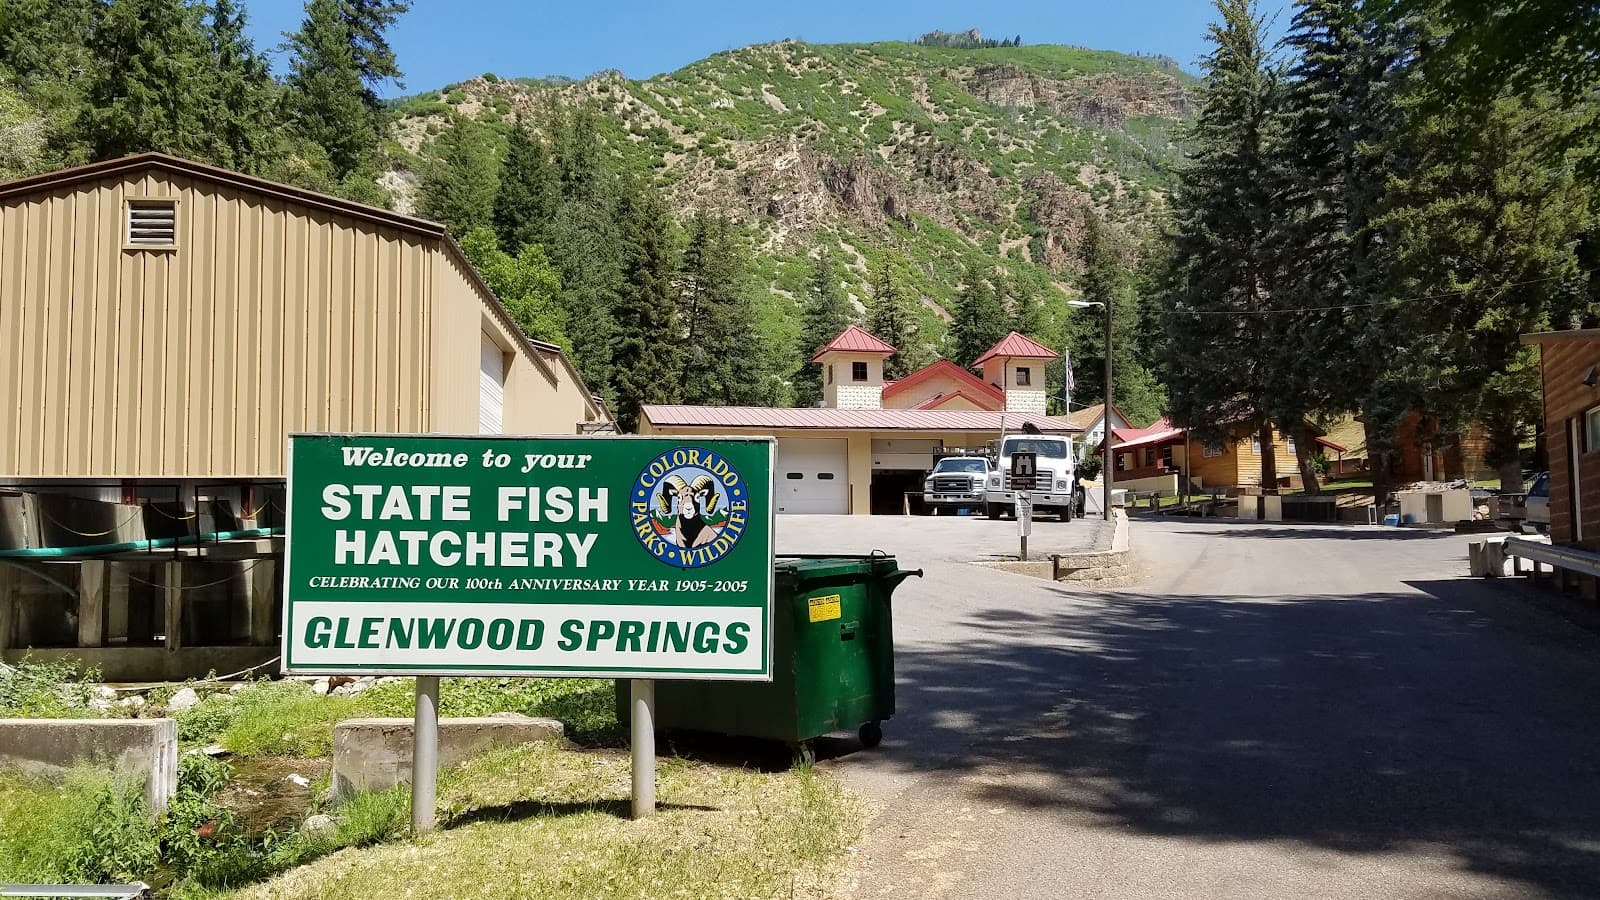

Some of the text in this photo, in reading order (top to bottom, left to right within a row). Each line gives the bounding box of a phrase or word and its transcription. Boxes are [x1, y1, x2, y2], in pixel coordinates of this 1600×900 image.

[340, 446, 593, 474] Welcome to your
[640, 449, 739, 488] COLORADO
[320, 483, 609, 523] STATE FISH
[335, 529, 599, 568] HATCHERY
[632, 500, 746, 565] PARKS WILDLIFE
[309, 576, 748, 592] CELEBRATING OUR 100th ANNIVERSARY YEAR 1905-2005
[304, 616, 751, 655] GLENWOOD SPRINGS
